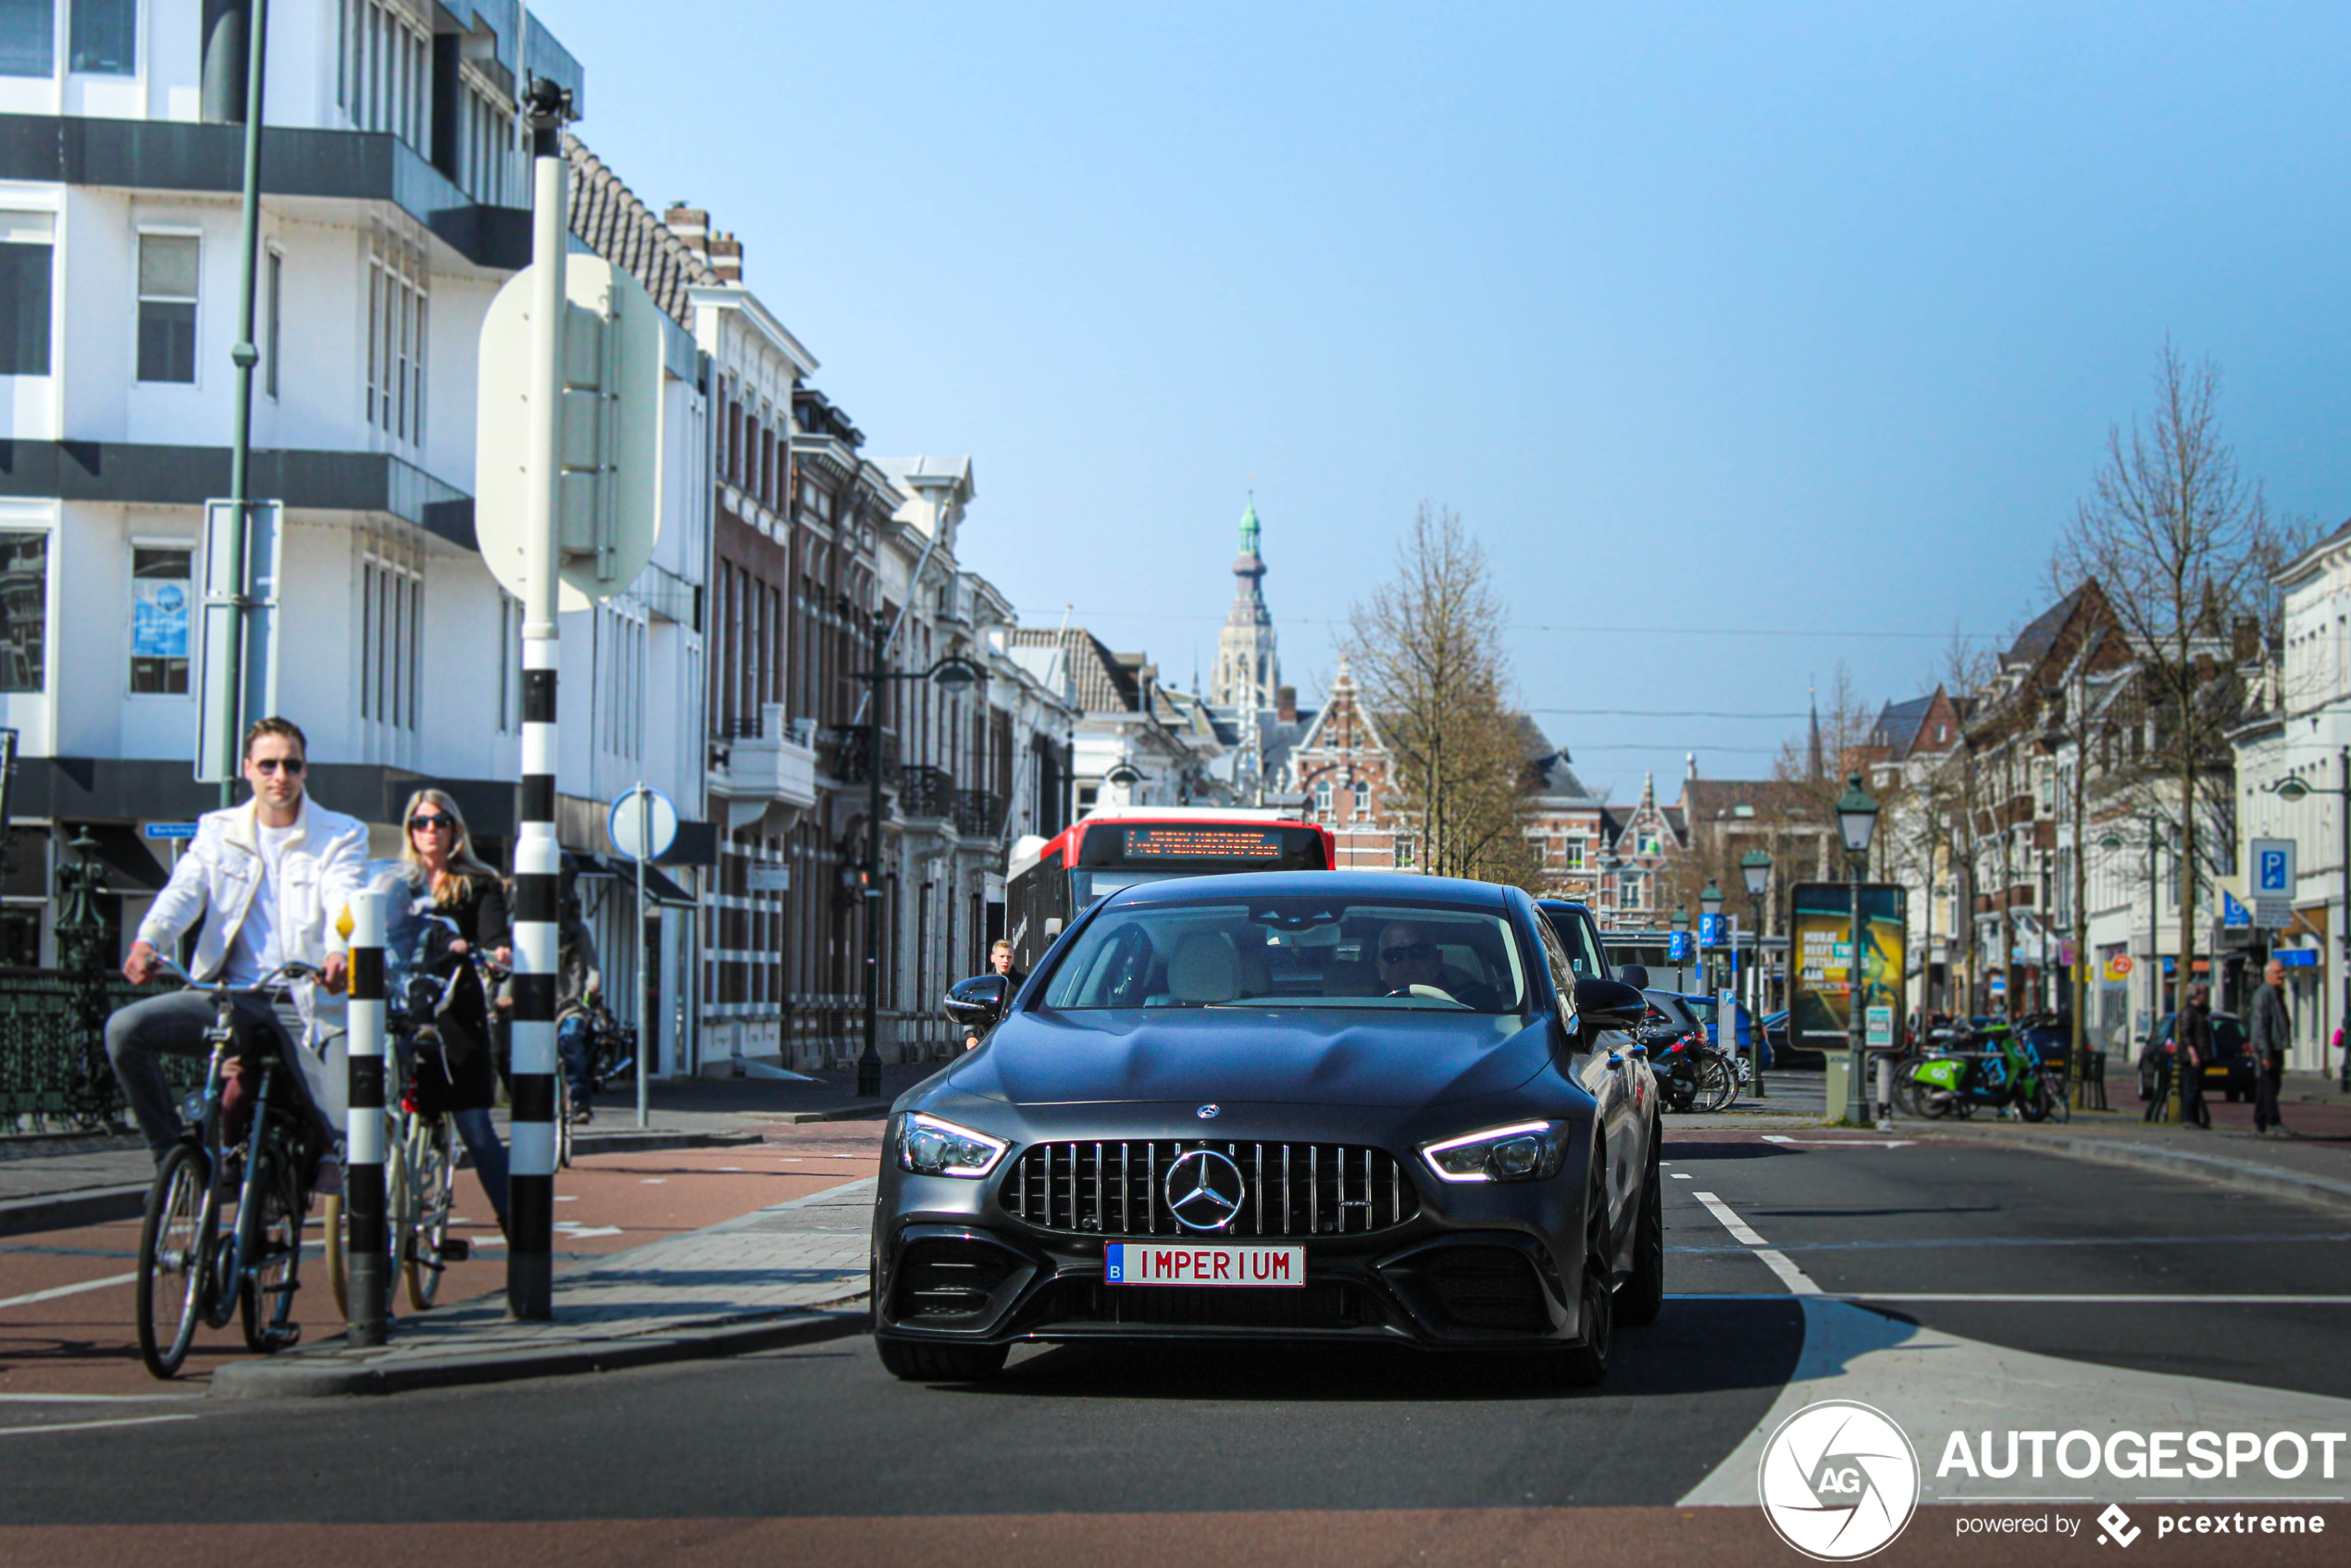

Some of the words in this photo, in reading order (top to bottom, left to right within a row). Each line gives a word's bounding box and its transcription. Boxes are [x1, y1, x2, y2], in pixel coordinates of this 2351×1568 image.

[2267, 853, 2281, 874] P
[1703, 917, 1712, 934] P
[1673, 935, 1680, 949] P
[1110, 1265, 1121, 1277] B
[1141, 1251, 1290, 1280] IMPERIUM
